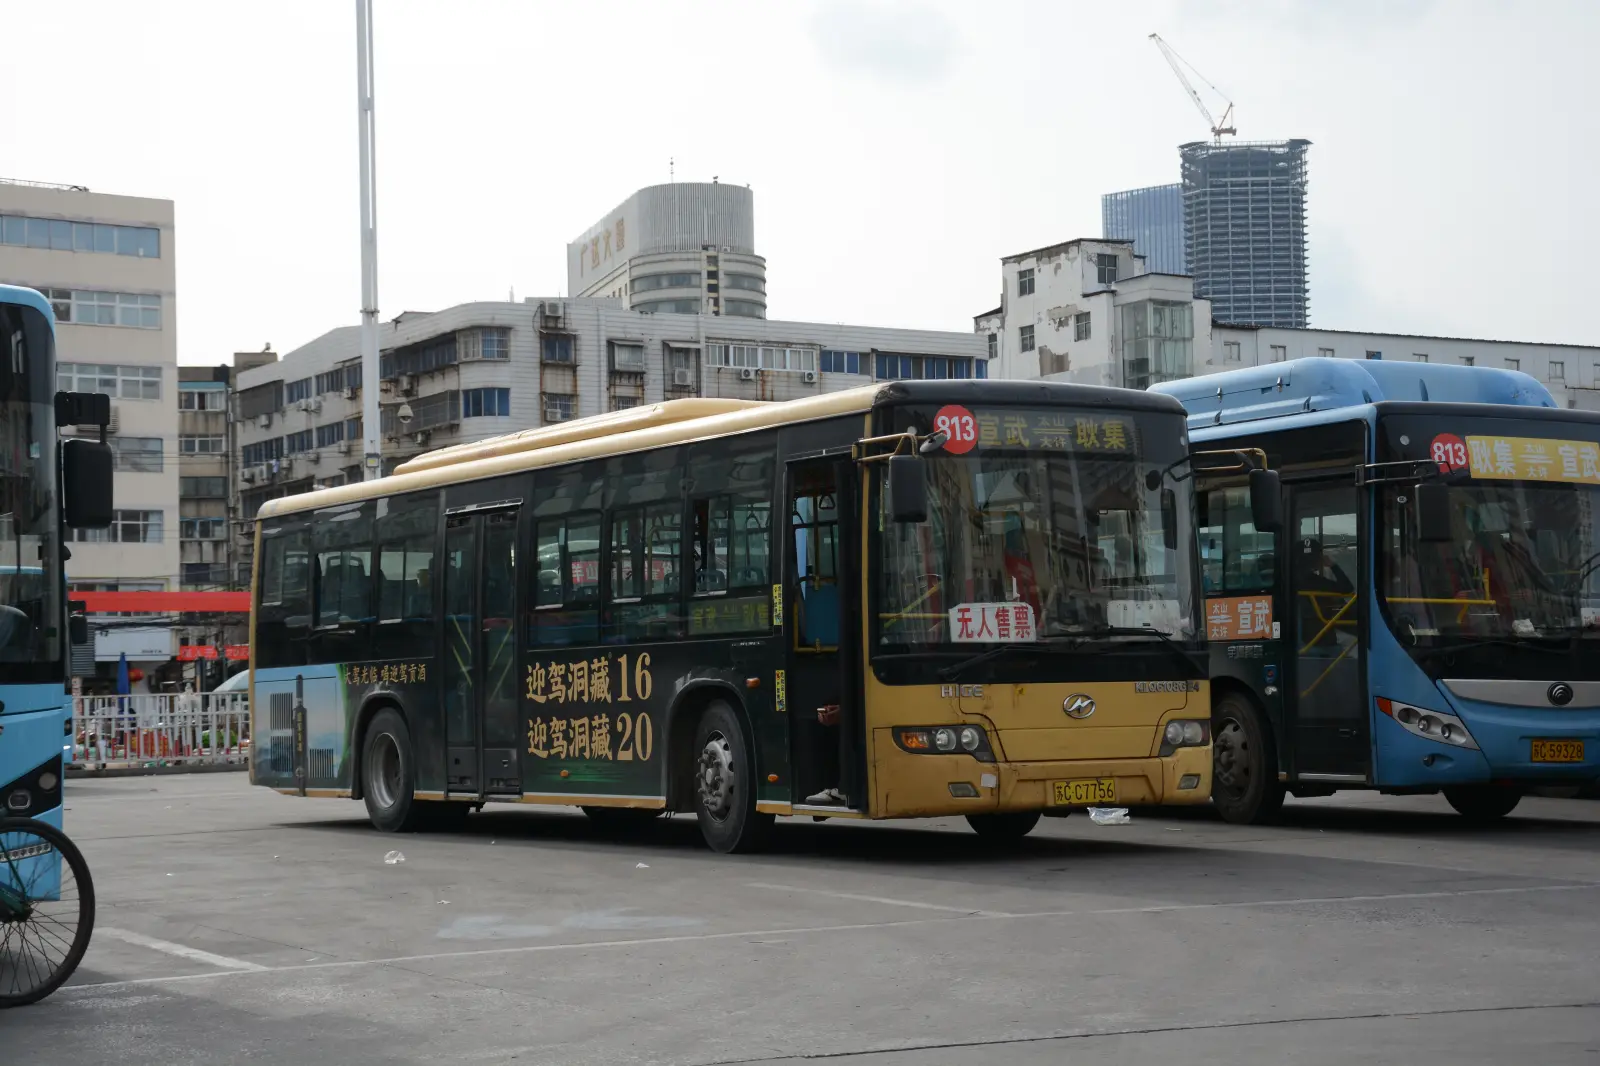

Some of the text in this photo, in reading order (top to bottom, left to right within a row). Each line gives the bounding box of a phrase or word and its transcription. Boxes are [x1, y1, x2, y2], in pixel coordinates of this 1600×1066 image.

[936, 415, 975, 442] 813
[976, 412, 1127, 450] 宣武 耿集
[1432, 441, 1467, 466] 813
[1469, 439, 1600, 480] 耿集 宣武
[957, 604, 1031, 639] 无人售票
[1237, 599, 1270, 635] 宣武
[526, 652, 653, 704] 迎驾洞藏 16
[941, 684, 984, 698] HIGE
[527, 712, 653, 761] 迎驾洞藏 20
